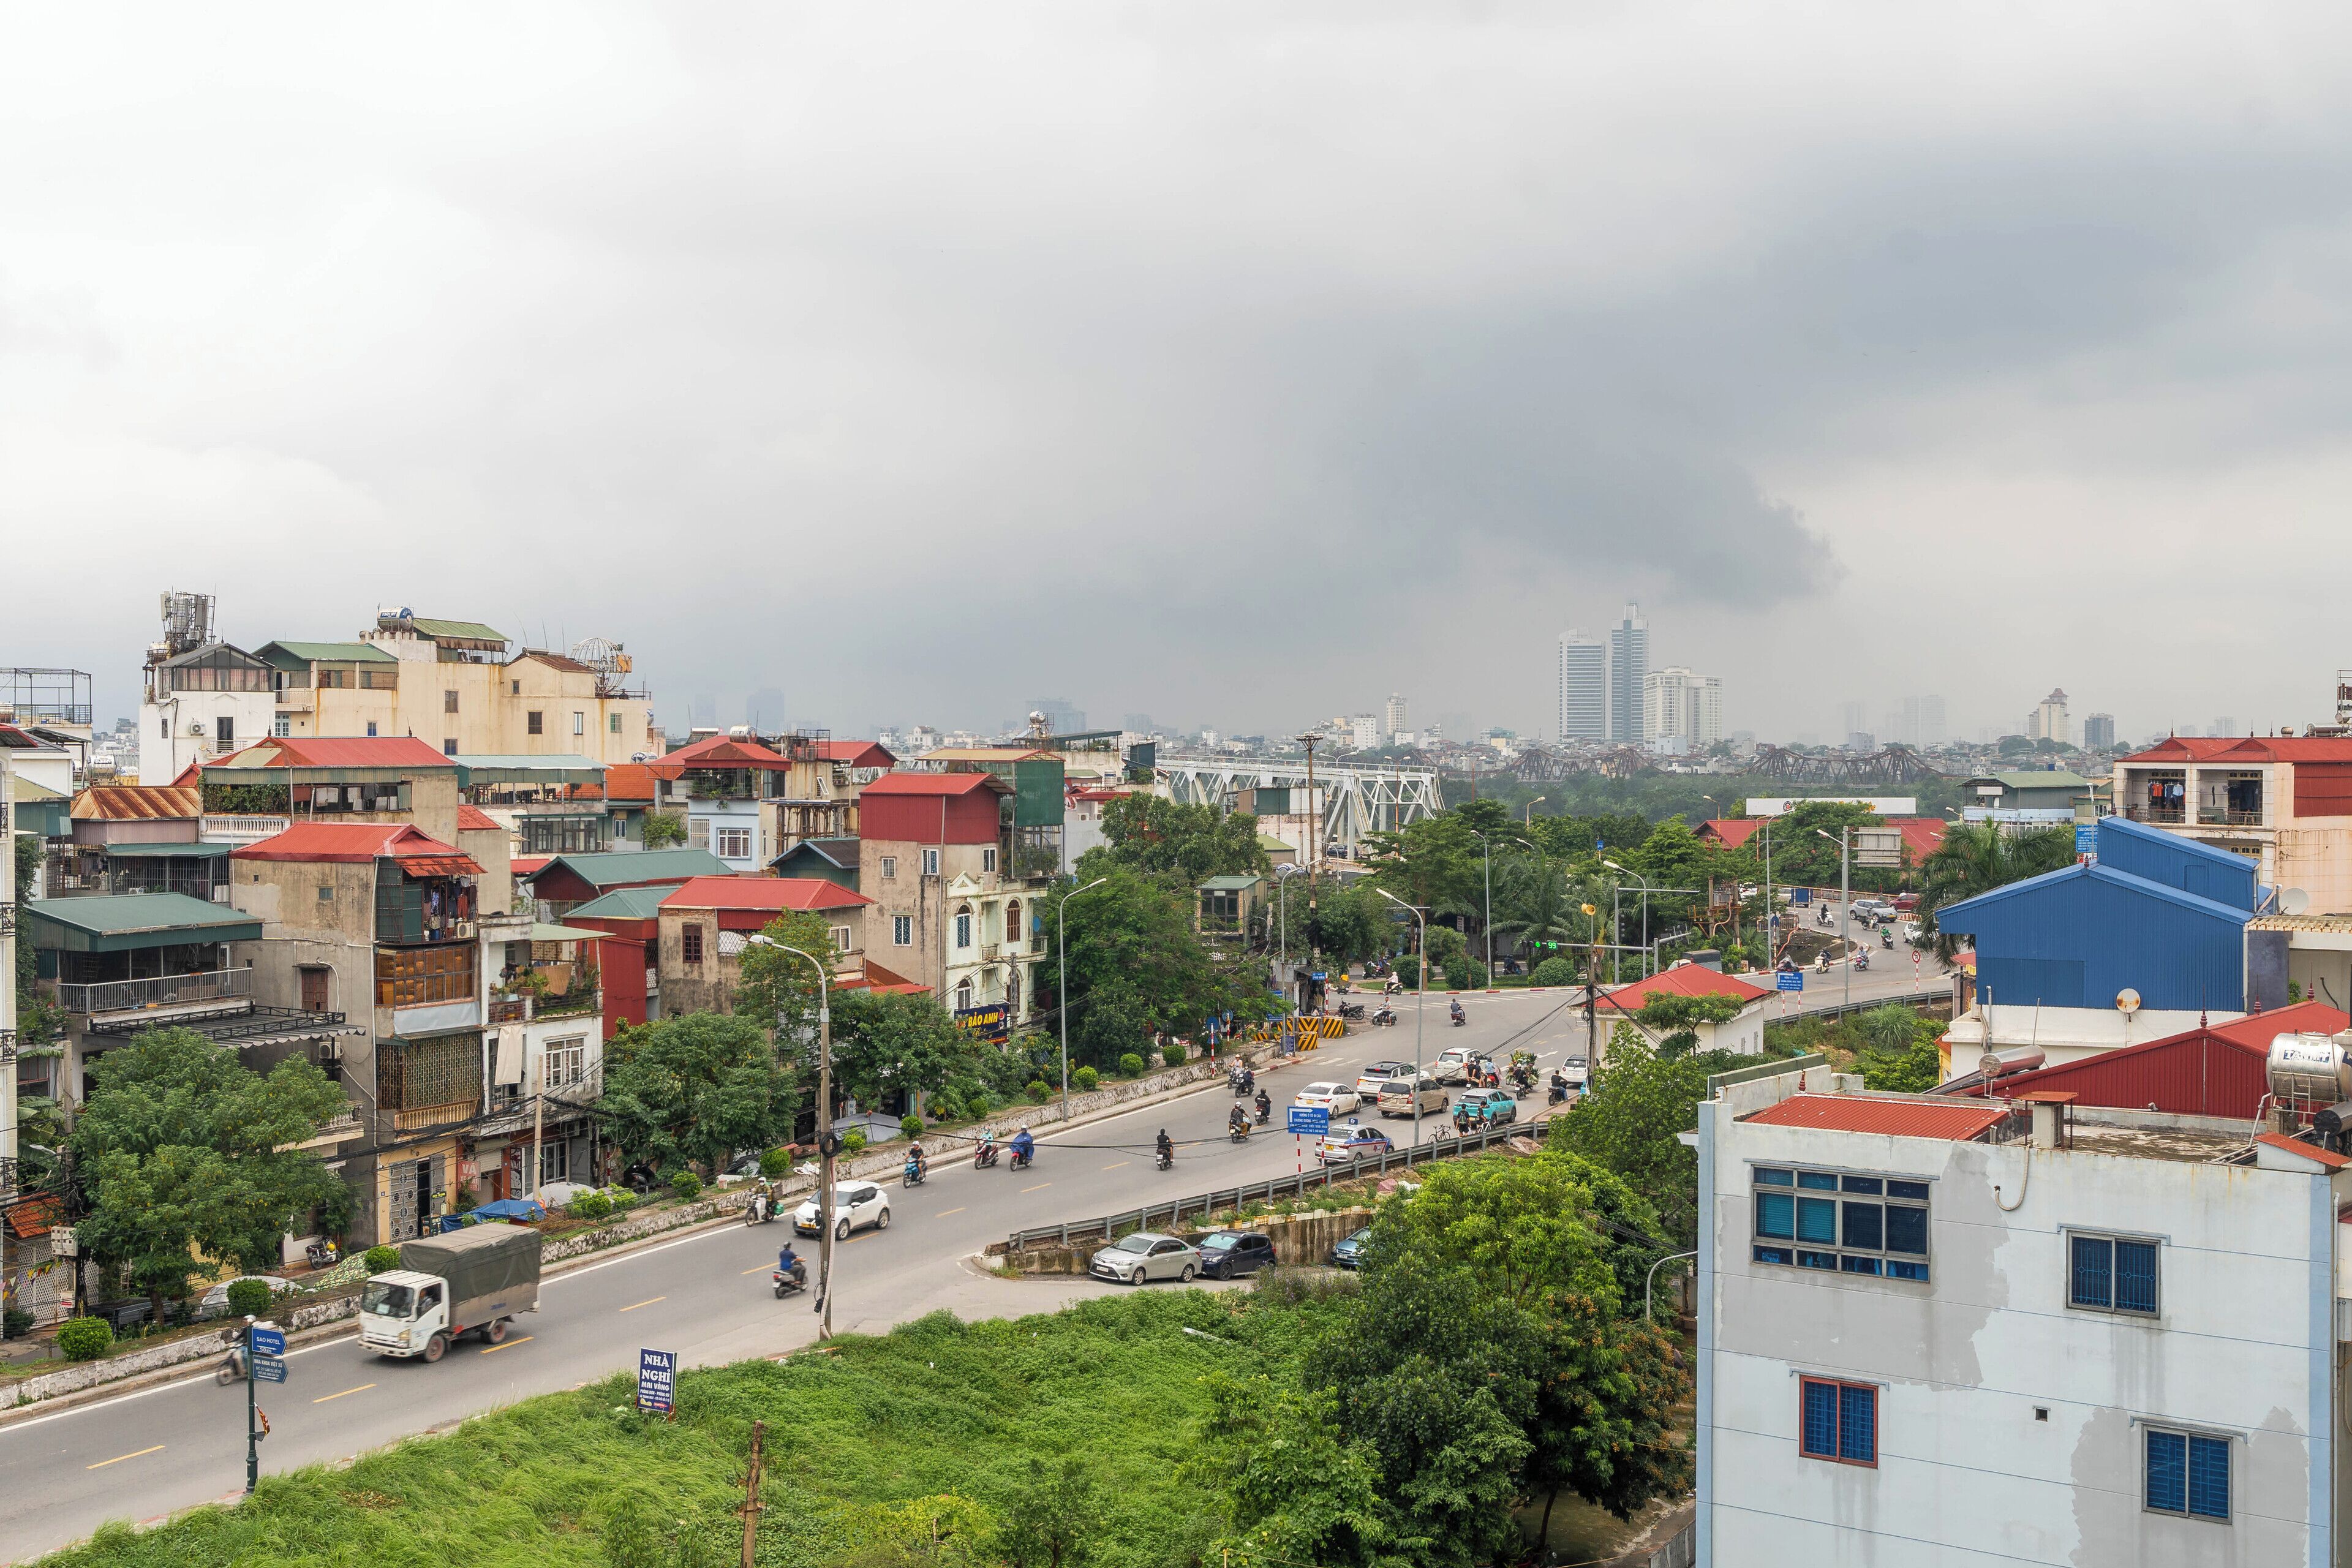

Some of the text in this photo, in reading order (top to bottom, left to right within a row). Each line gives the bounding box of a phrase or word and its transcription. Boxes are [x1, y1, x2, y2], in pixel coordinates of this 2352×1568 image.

[968, 1012, 998, 1027] BẢO ANH
[644, 1354, 669, 1367] NHÀ
[641, 1369, 671, 1383] NGHỈ
[654, 1382, 669, 1391] VÀNG
